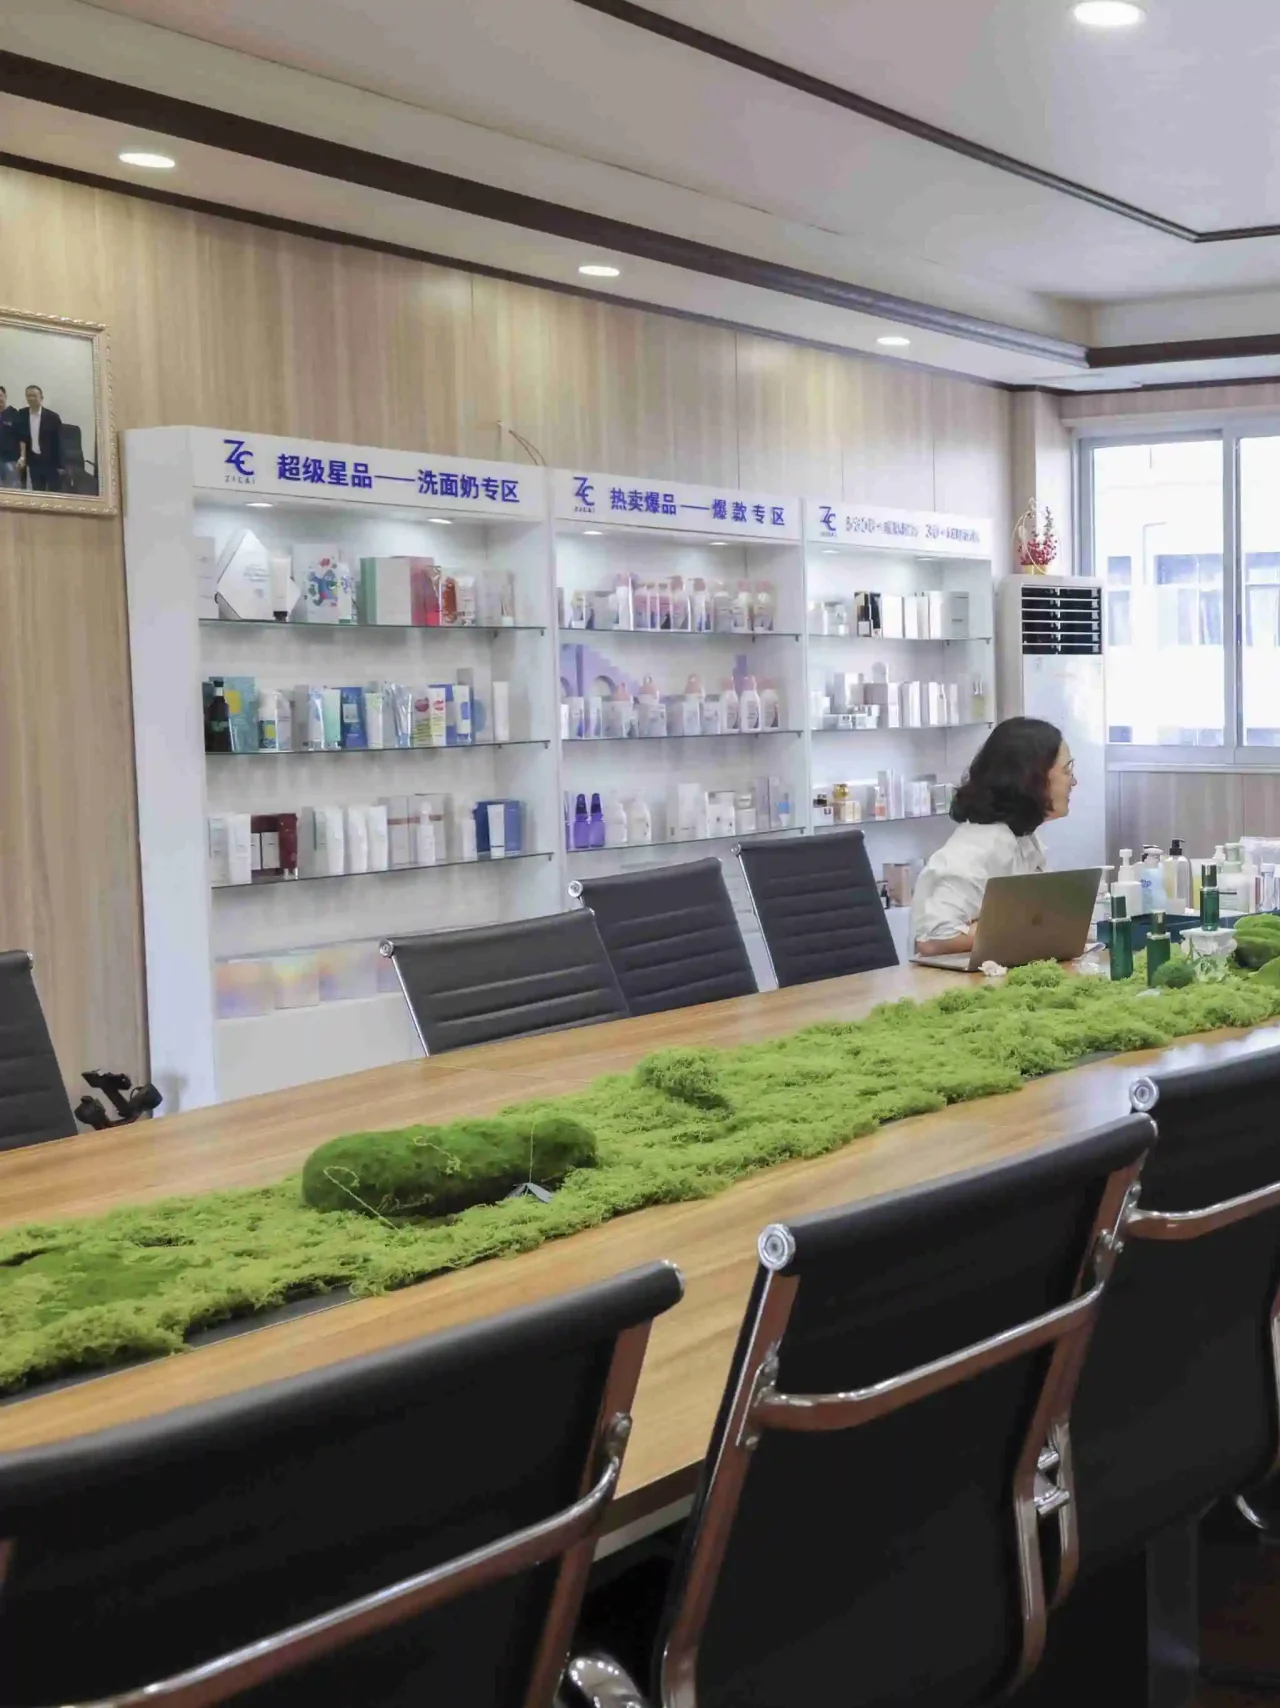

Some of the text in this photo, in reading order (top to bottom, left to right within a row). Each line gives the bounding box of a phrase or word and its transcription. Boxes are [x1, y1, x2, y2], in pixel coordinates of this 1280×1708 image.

[277, 453, 520, 503] 超级星品——洗面奶专区
